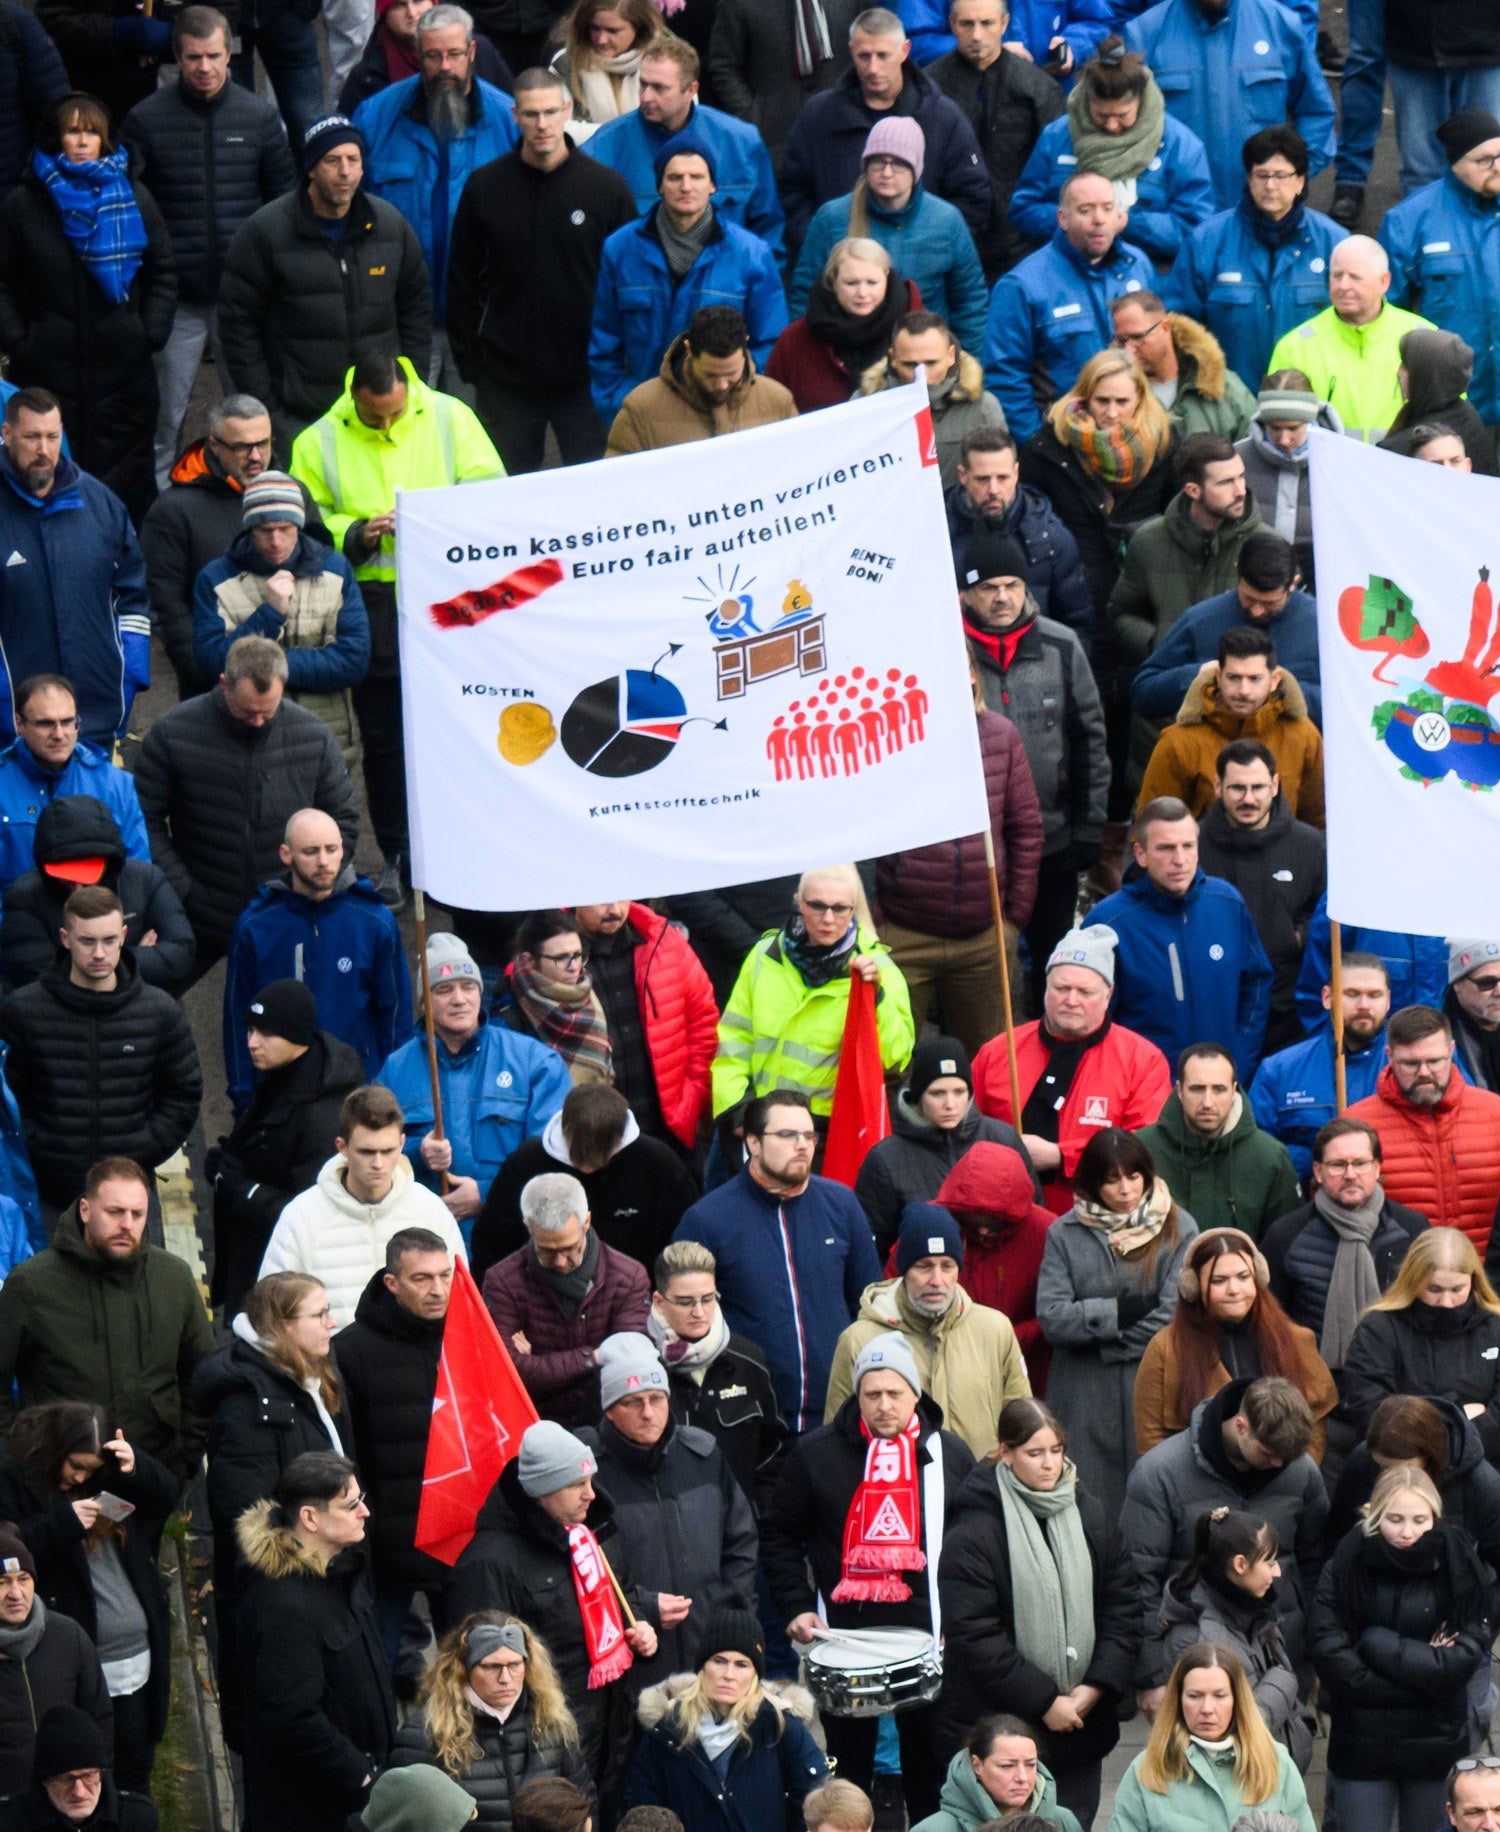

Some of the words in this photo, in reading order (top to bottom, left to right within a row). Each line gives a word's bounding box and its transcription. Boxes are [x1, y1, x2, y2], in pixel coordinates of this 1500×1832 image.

[446, 542, 518, 565] Oben
[530, 517, 677, 557] kassieren,
[687, 496, 764, 528] unten
[572, 555, 636, 580] Euro
[645, 543, 695, 569] fair
[704, 505, 838, 557] aufteilen!
[850, 548, 896, 569] RENTE
[461, 684, 535, 699] KOSTEN
[588, 789, 762, 817] Kunststofftechnik
